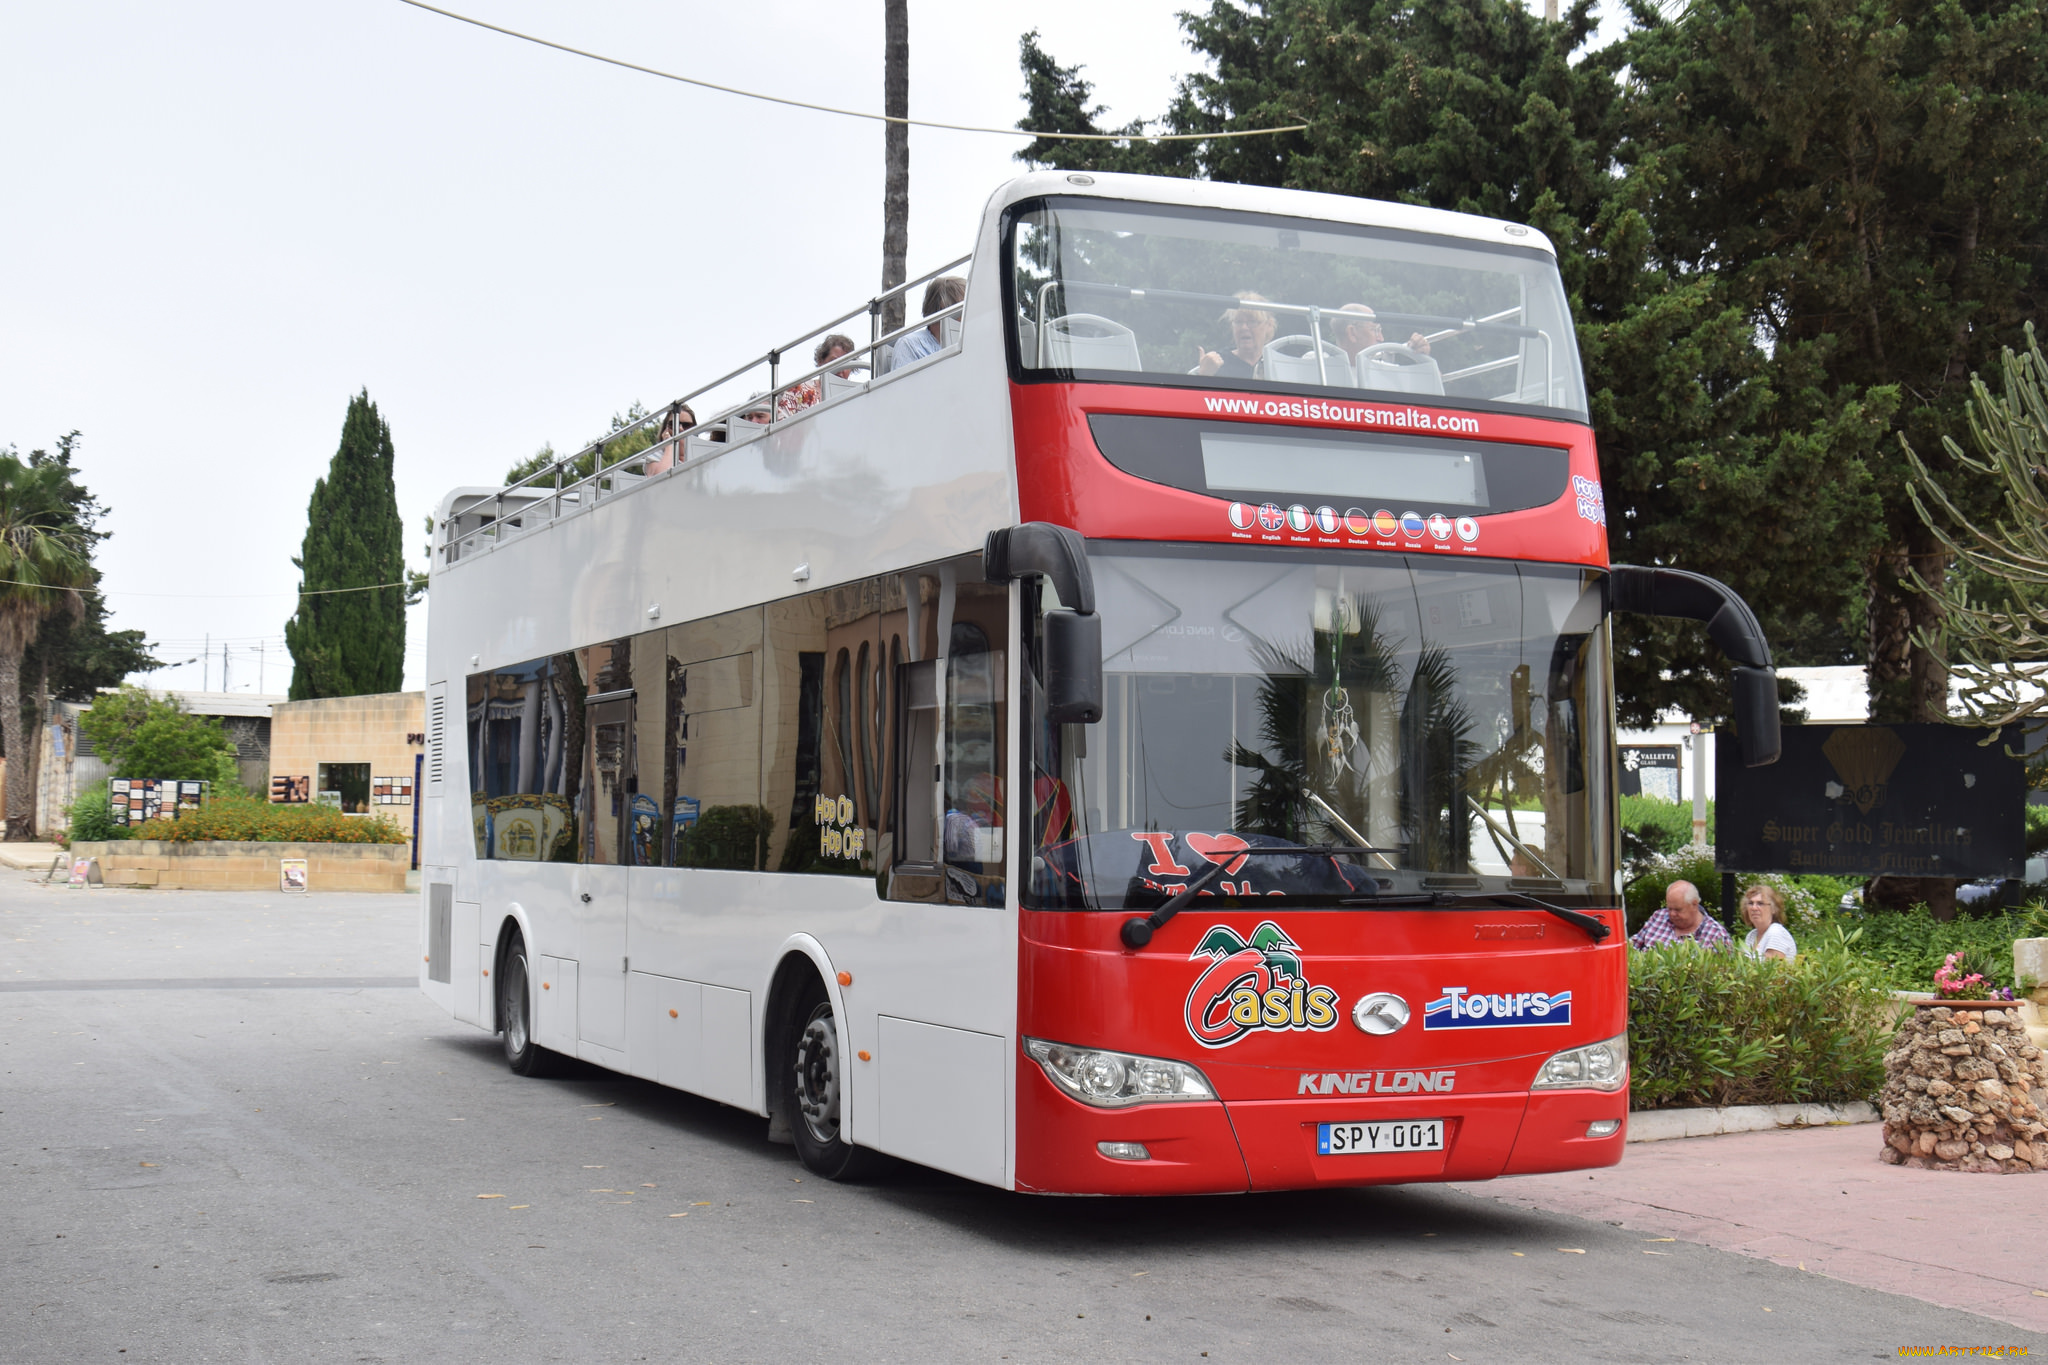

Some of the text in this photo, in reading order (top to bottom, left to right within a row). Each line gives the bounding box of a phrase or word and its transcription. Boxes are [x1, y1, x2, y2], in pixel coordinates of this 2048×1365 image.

[1203, 397, 1480, 433] www.oasistoursmalta.com
[1572, 475, 1596, 503] Hop
[1577, 497, 1600, 524] Hop
[815, 793, 854, 828] Hop On
[820, 825, 865, 860] Hop Off
[1761, 818, 1819, 844] Super
[1825, 820, 1873, 844] Gold
[1131, 832, 1191, 876] I
[1184, 946, 1340, 1049] Oasis
[1441, 986, 1552, 1019] Tours
[1297, 1070, 1456, 1095] KING LONG
[1333, 1124, 1439, 1150] SPY 001
